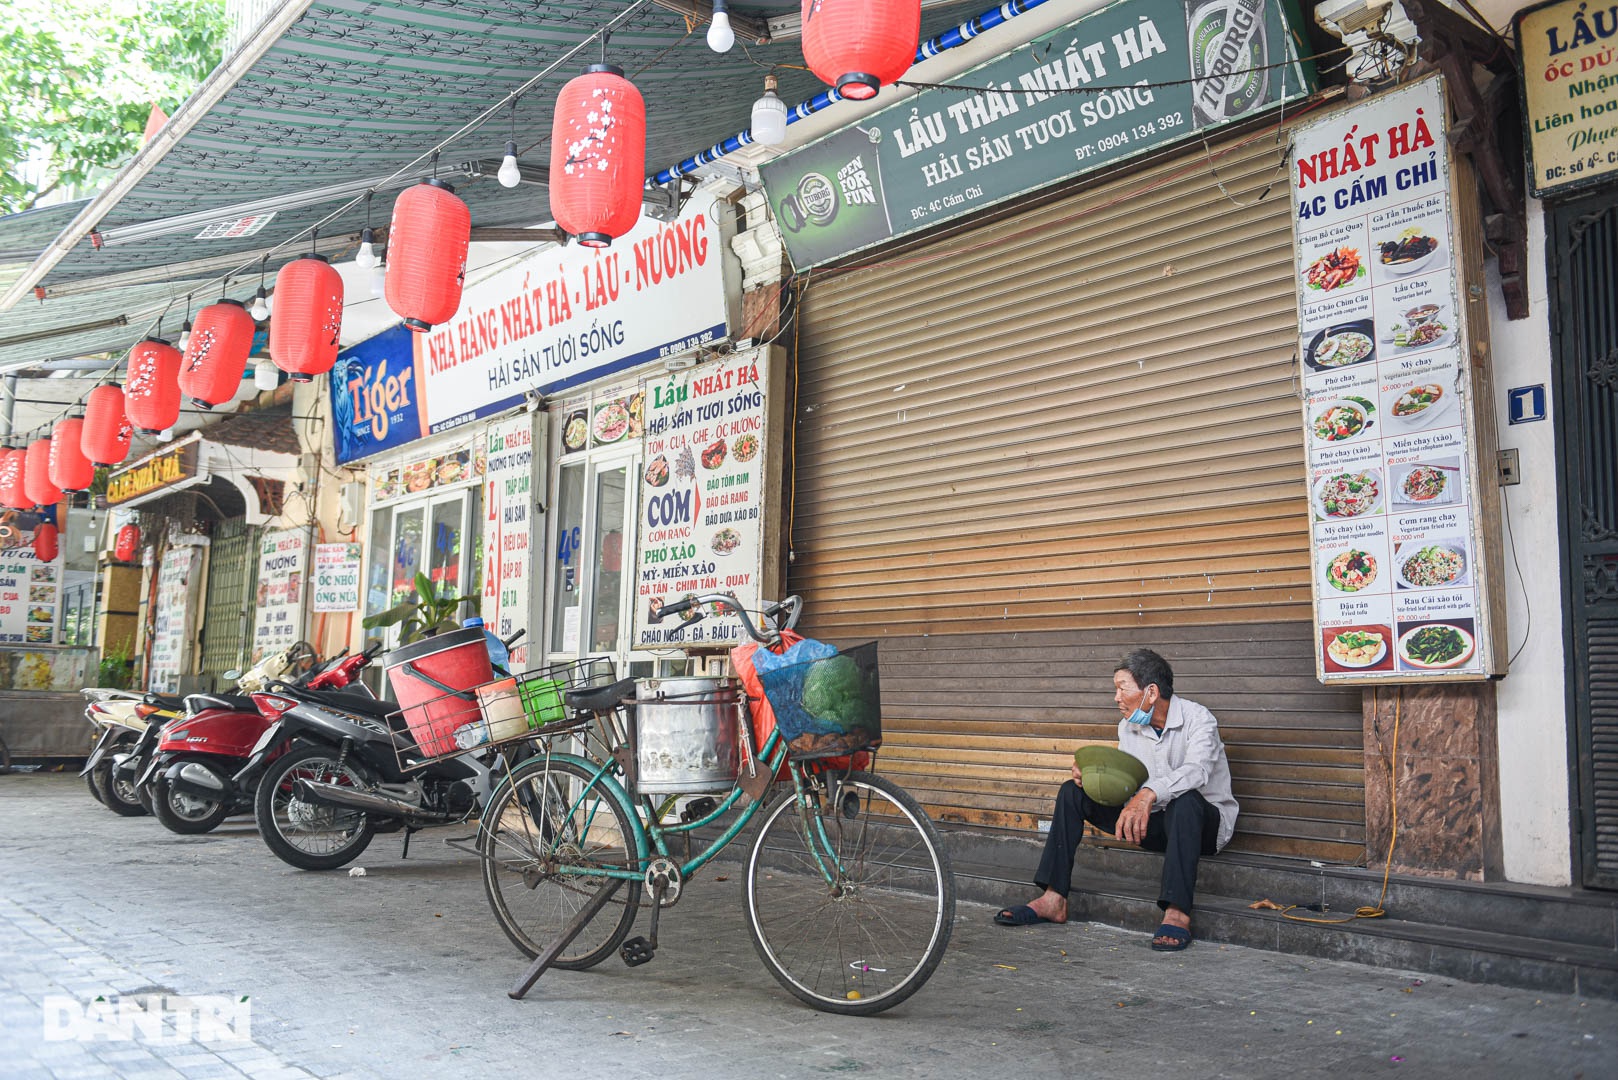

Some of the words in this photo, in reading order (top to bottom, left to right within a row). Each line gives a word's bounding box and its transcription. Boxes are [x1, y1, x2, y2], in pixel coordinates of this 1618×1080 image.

[1200, 8, 1254, 110] TUBORG
[1544, 59, 1574, 82] ỐC
[893, 107, 947, 158] LẨU
[947, 81, 1019, 134] THÁI
[1018, 38, 1107, 107] NHẤT
[1111, 16, 1167, 69] HÀ
[1245, 63, 1260, 98] GREEN
[1535, 113, 1574, 133] Liên
[1075, 144, 1096, 160] ĐT:
[1098, 131, 1129, 152] 0904
[1132, 122, 1155, 140] 134
[1157, 112, 1184, 131] 392
[921, 153, 964, 187] HẢI
[966, 136, 1013, 170] SẢN
[1015, 109, 1077, 150] TƯƠI
[1297, 124, 1379, 188] NHẤT
[1387, 108, 1435, 159] HÀ
[837, 155, 863, 181] OPEN
[1570, 157, 1583, 174] số
[840, 170, 871, 193] FOR
[1300, 195, 1326, 220] 4C
[1334, 174, 1387, 210] CẤM
[1396, 151, 1437, 190] CHỈ
[804, 188, 831, 204] TUBORG
[844, 186, 876, 205] FUN
[910, 206, 928, 219] ĐC:
[929, 199, 941, 213] 4C
[1373, 214, 1383, 223] Gà
[1392, 217, 1412, 227] chicken
[1414, 212, 1425, 220] with
[1427, 208, 1442, 216] herbs
[1346, 222, 1363, 232] Quay
[428, 321, 457, 376] NHÀ
[458, 306, 498, 363] HÀNG
[500, 267, 542, 345] NHẤT
[546, 263, 572, 326] HÀ
[633, 213, 708, 291] NƯỚNG
[1336, 299, 1353, 308] Chim
[513, 348, 541, 379] SẢN
[543, 334, 577, 370] TƯƠI
[580, 318, 625, 357] SỐNG
[670, 341, 686, 354] 0904
[687, 336, 699, 348] 134
[700, 331, 713, 343] 392
[1415, 358, 1432, 367] chay
[654, 374, 688, 409] Lẩu
[693, 364, 733, 399] NHẤT
[1340, 374, 1356, 382] chay
[348, 359, 411, 441] Tiger
[672, 406, 693, 428] SẢN
[697, 401, 723, 420] TƯƠI
[728, 389, 761, 414] SỐNG
[1515, 389, 1541, 420] 1
[390, 413, 403, 424] 1932
[490, 427, 503, 453] Lẩu
[648, 437, 664, 454] TÔM
[670, 434, 686, 450] CUA
[693, 428, 708, 446] GHẸ
[731, 415, 760, 436] HƯƠNG
[1414, 437, 1430, 446] chay
[517, 450, 531, 467] CHỌN
[1335, 449, 1350, 458] chay
[721, 473, 735, 487] TÔM
[737, 472, 749, 484] RIM
[720, 491, 730, 506] GÀ
[730, 490, 748, 504] RANG
[648, 489, 691, 528] CƠM
[734, 507, 747, 521] XÀO
[1399, 518, 1417, 526] Cơm
[1439, 513, 1456, 521] chay
[1400, 525, 1429, 533] Vegetarian
[649, 530, 667, 543] CƠM
[667, 527, 691, 540] RANG
[1338, 525, 1353, 534] chay
[517, 532, 527, 549] CUA
[644, 543, 668, 564] PHỞ
[670, 541, 696, 561] XÀO
[265, 555, 297, 571] NƯỚNG
[662, 561, 689, 578] MIẾN
[692, 560, 716, 575] XÀO
[318, 570, 332, 586] ỐC
[640, 581, 651, 595] GÀ
[676, 576, 697, 591] CHIM
[726, 573, 750, 587] QUAY
[316, 588, 336, 603] ỐNG
[502, 588, 509, 607] GÀ
[511, 590, 517, 606] TA
[1404, 597, 1419, 605] Rau
[693, 623, 703, 640] GÀ
